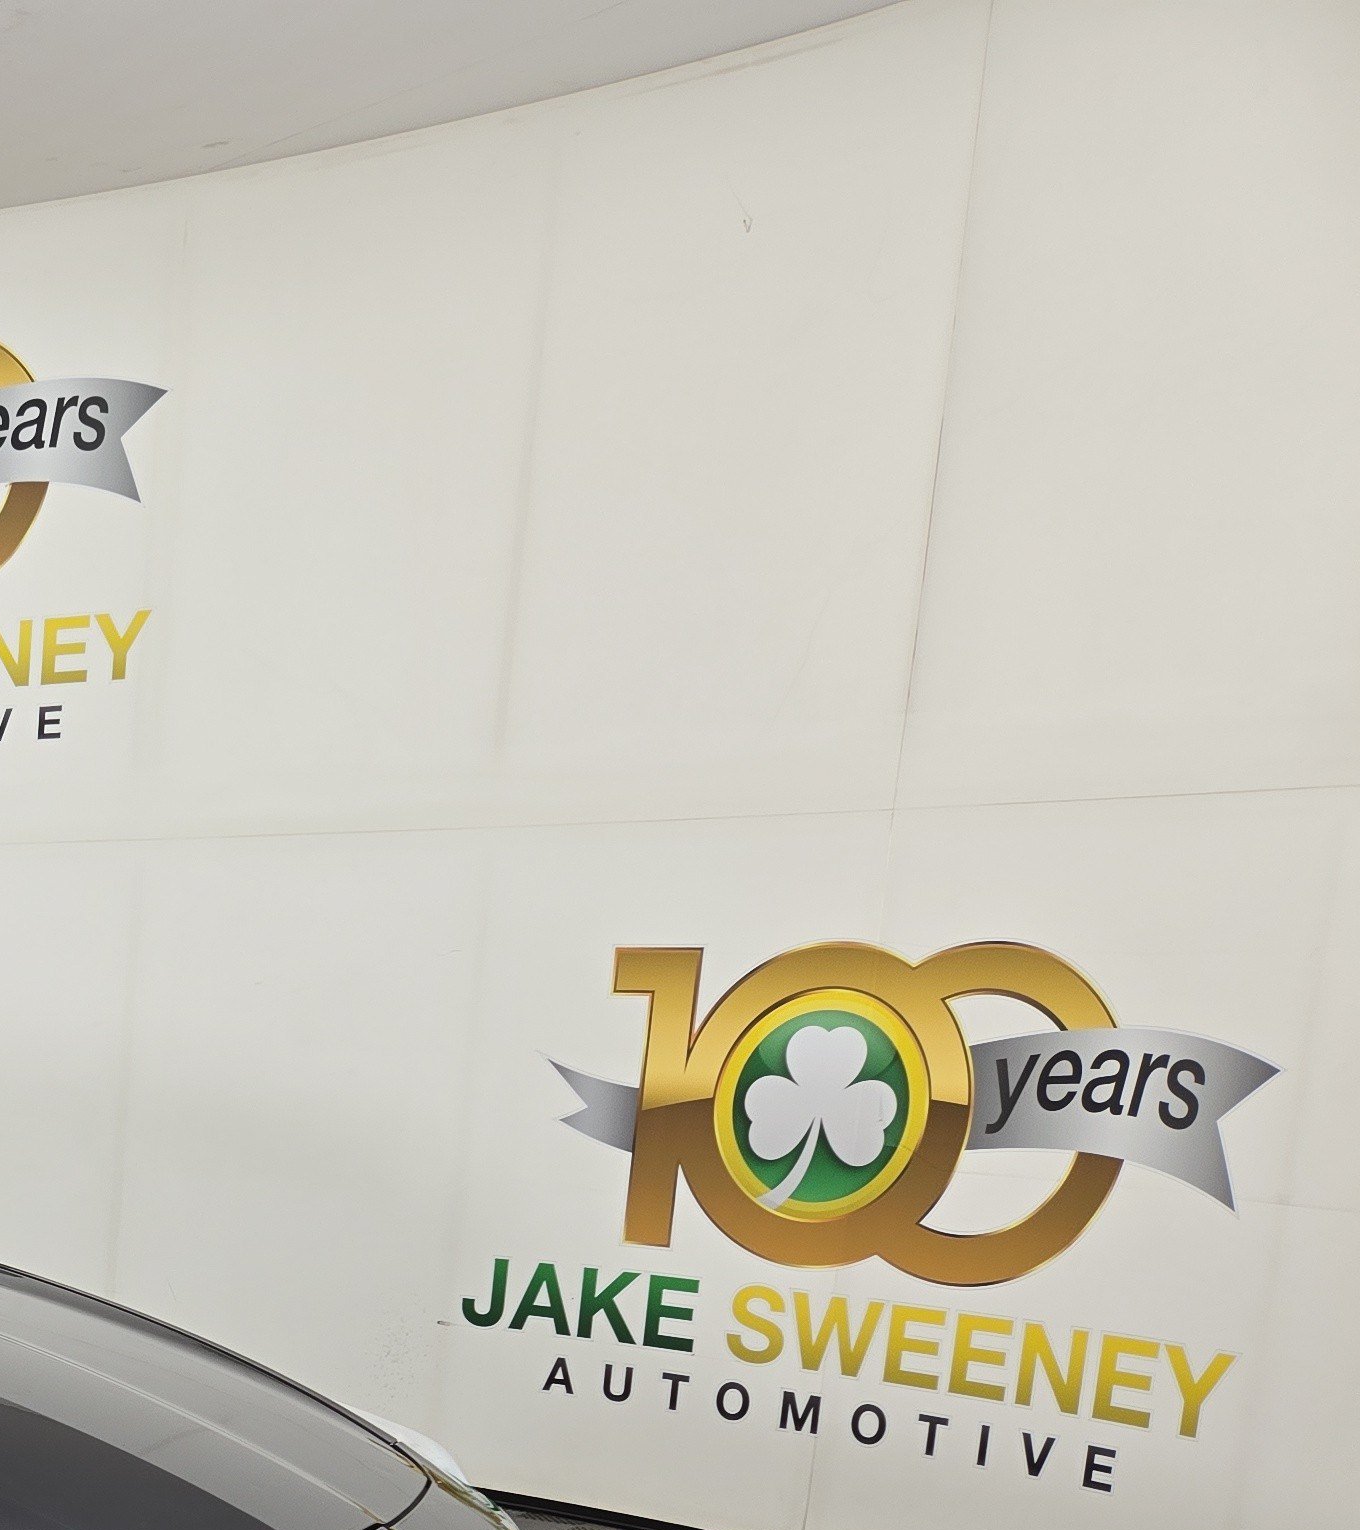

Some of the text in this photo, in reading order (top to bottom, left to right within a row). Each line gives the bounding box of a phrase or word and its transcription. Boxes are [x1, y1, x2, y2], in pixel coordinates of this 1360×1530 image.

[613, 940, 1206, 1288] 100 years
[462, 1258, 1237, 1439] JAKE SWEENEY
[543, 1358, 1117, 1492] AUTOMOTIVE
